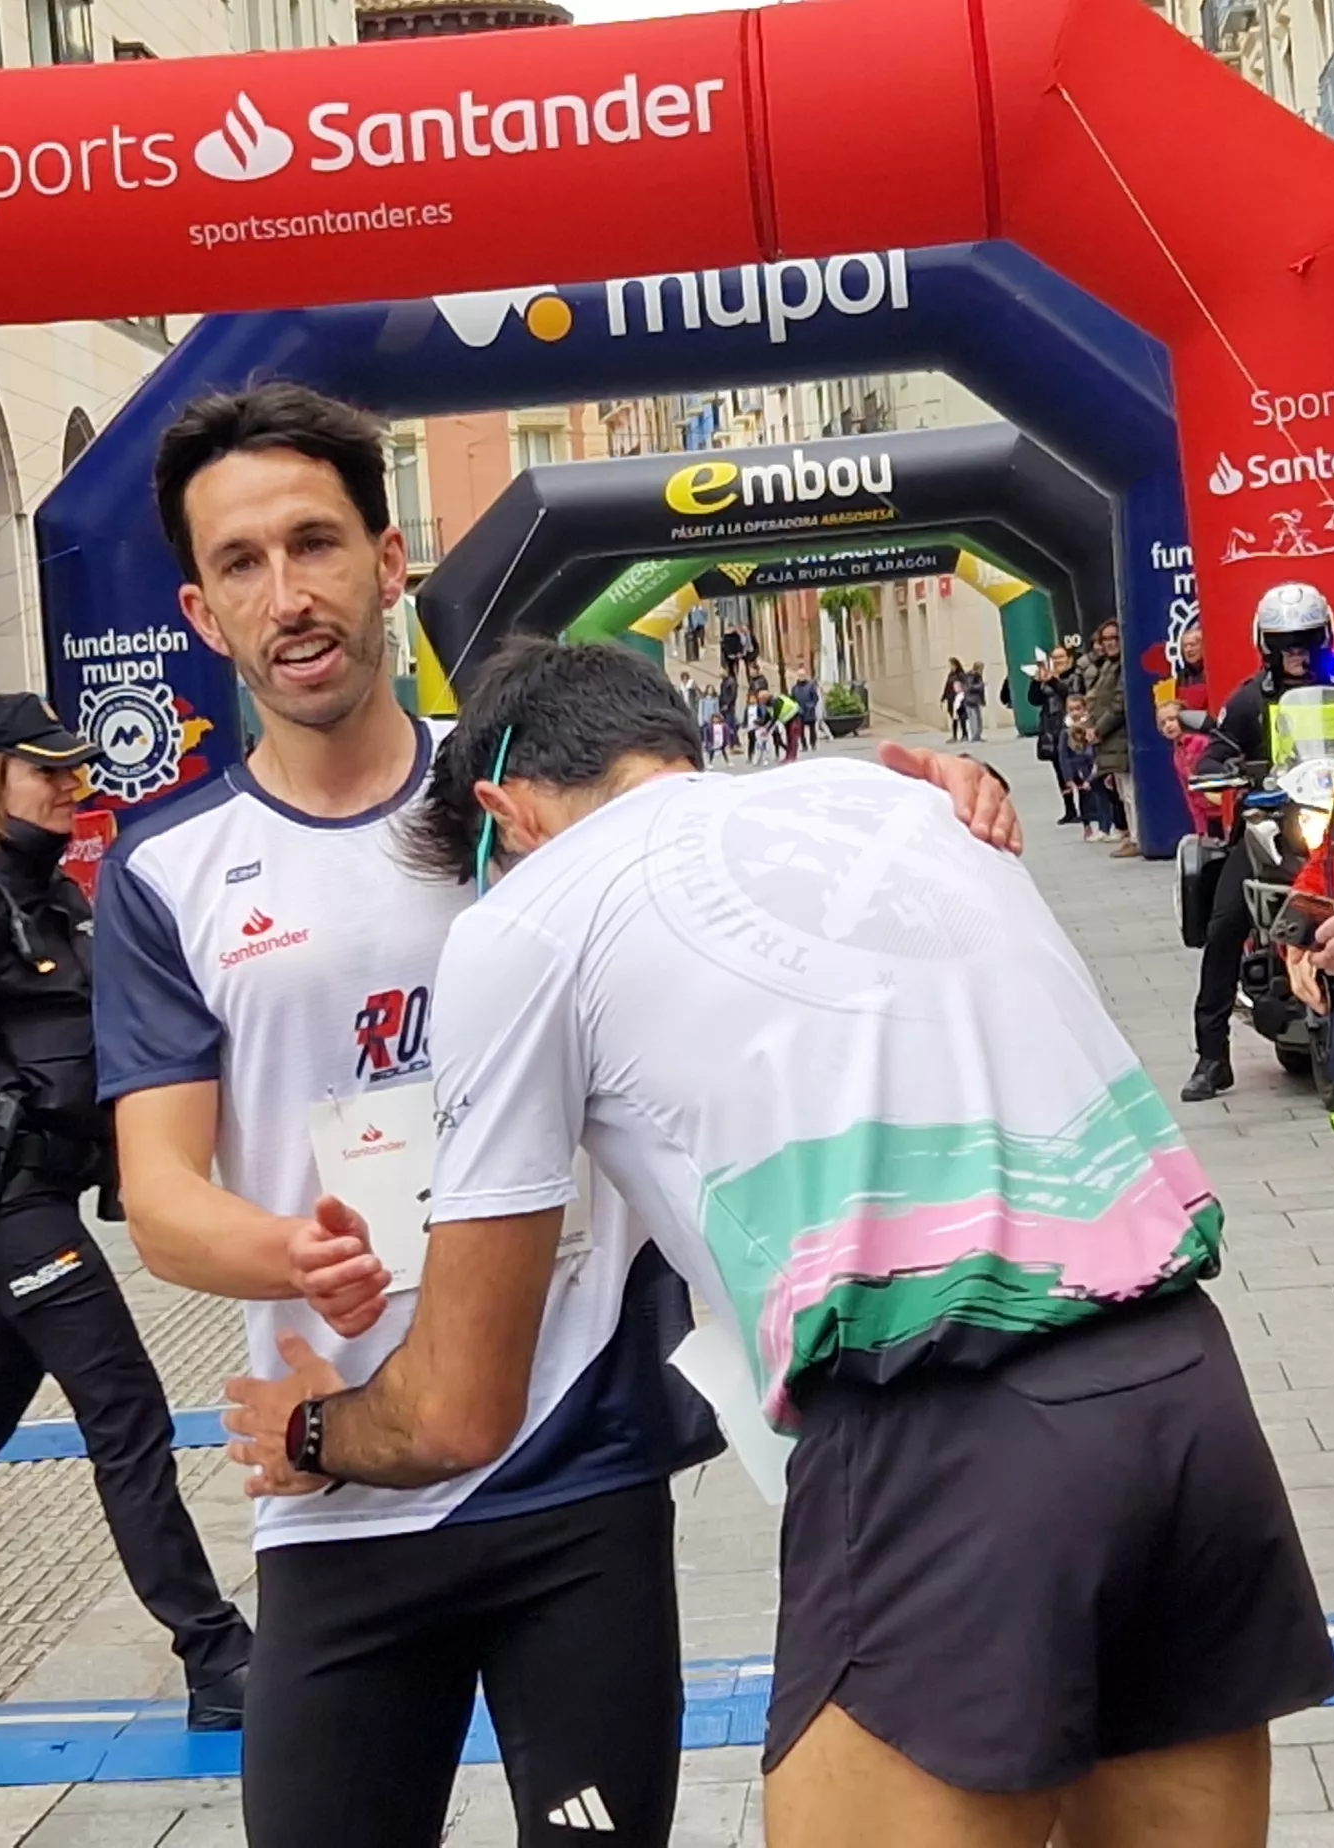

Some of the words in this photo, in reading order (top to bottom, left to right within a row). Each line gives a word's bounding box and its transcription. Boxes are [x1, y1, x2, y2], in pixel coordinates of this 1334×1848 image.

[308, 73, 724, 172] Santander
[189, 201, 453, 249] sportssantander.es
[605, 248, 909, 343] mupol
[665, 449, 893, 515] embou
[756, 571, 794, 584] CAJA
[799, 565, 847, 580] RURAL
[851, 562, 870, 575] DE
[62, 623, 189, 661] fundación
[82, 653, 164, 686] mupol
[219, 928, 311, 969] Santander
